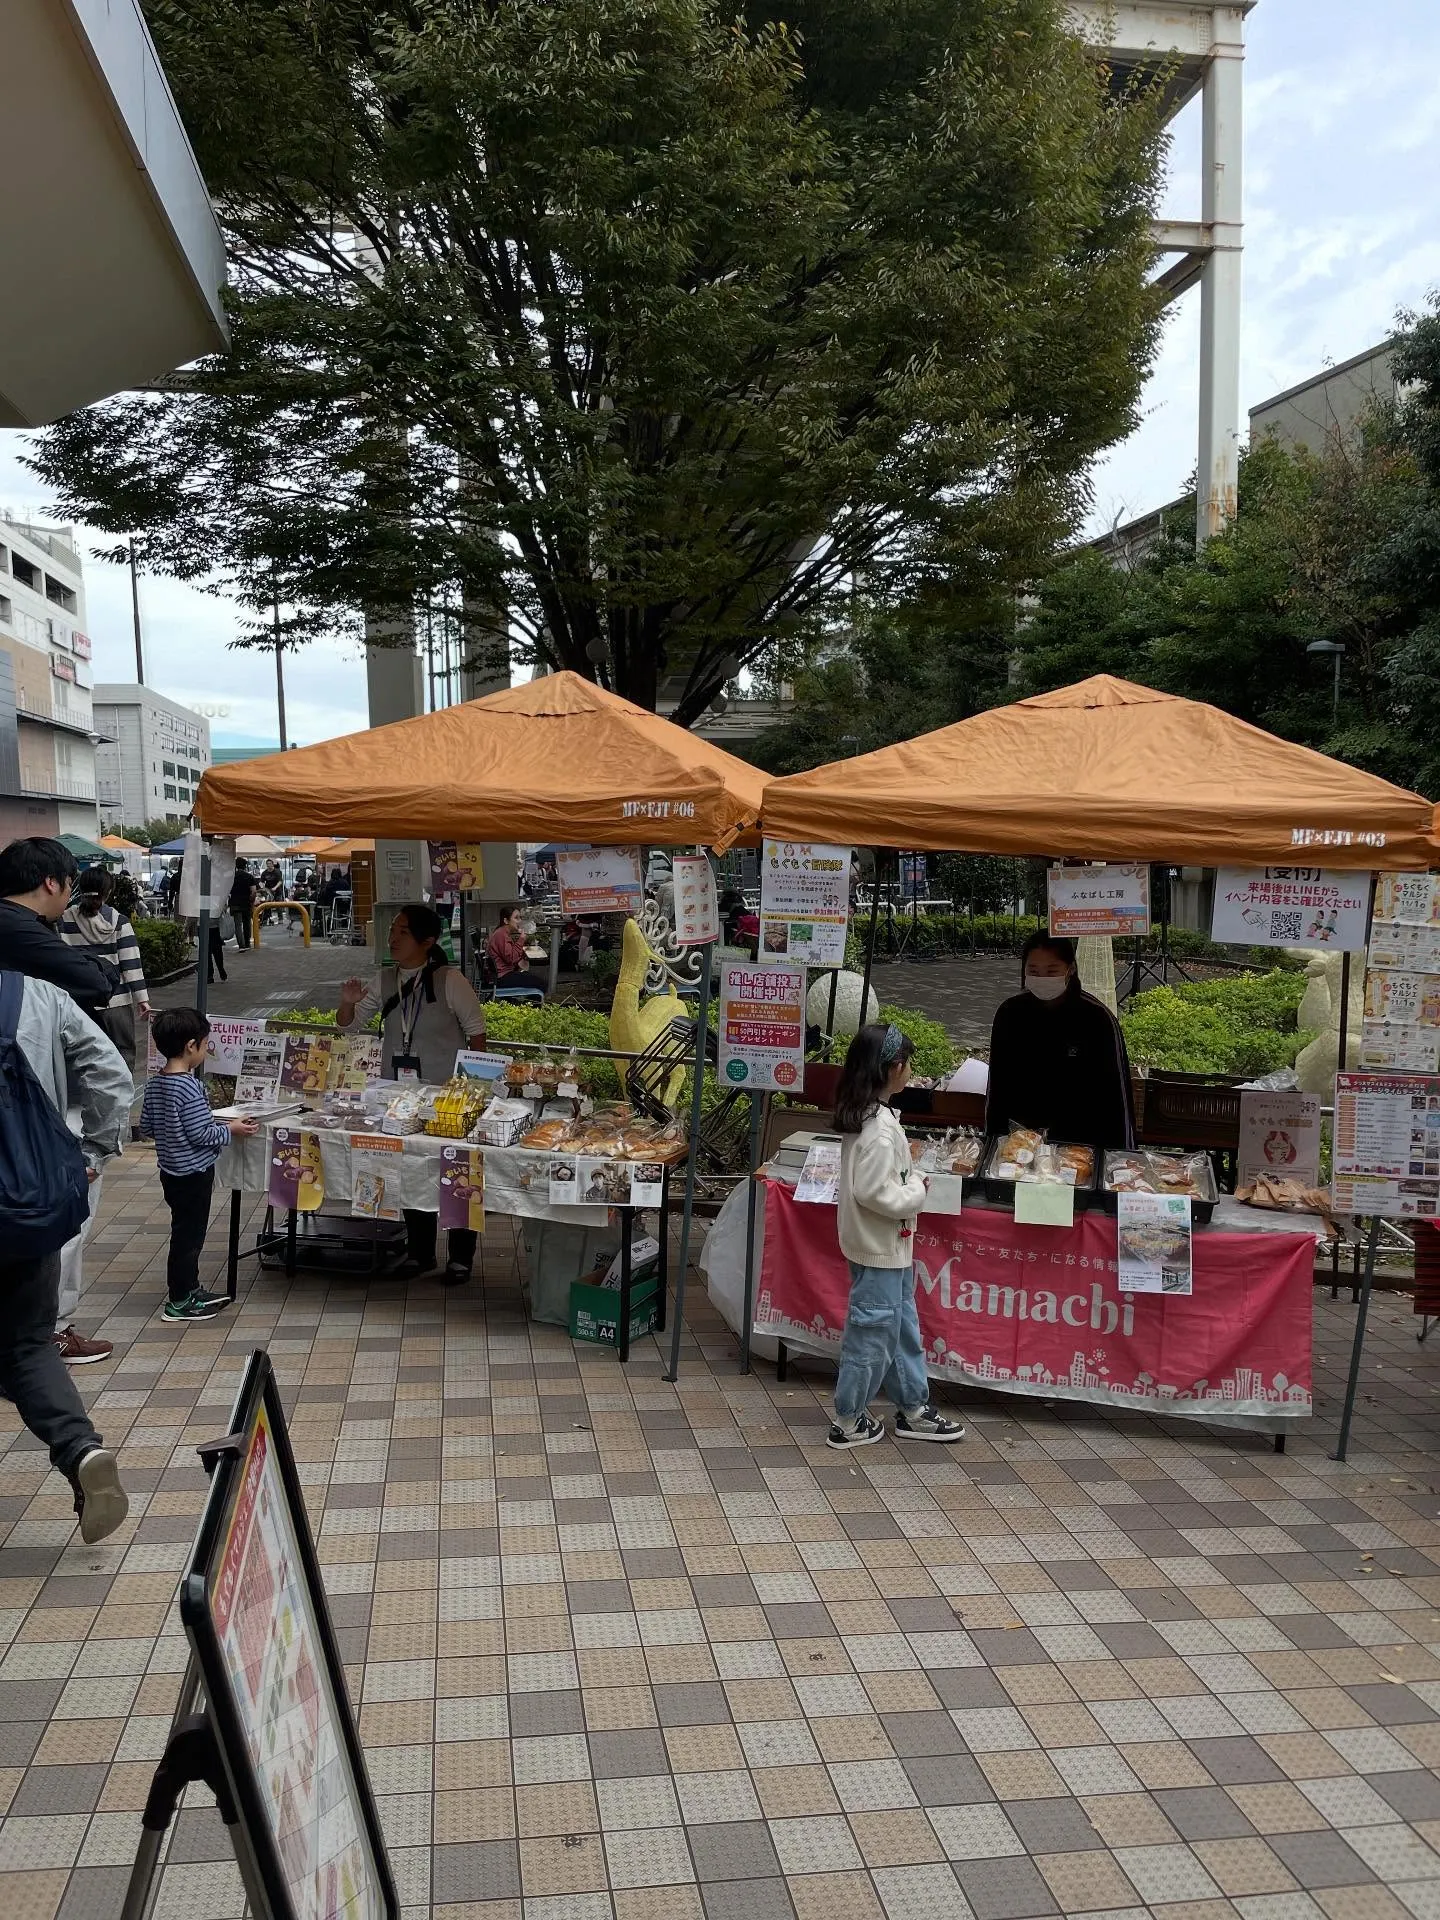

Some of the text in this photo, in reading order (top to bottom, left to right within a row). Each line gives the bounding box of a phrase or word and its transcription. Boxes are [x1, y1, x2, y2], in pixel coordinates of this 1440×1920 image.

[673, 802, 695, 818] #06
[1357, 832, 1386, 847] #03
[588, 871, 609, 879] リアン
[1248, 882, 1340, 896] 来場後はLINEから
[1403, 883, 1430, 891] もぐもぐ
[1071, 889, 1124, 899] ふなばし工房
[1402, 891, 1429, 899] マルシェ
[729, 971, 802, 989] 推し店舗投票
[1391, 982, 1418, 990] もぐもぐ
[1391, 989, 1418, 997] マルシェ
[246, 1037, 257, 1046] My
[912, 1256, 1135, 1338] Mamachi
[600, 1326, 616, 1339] A4
